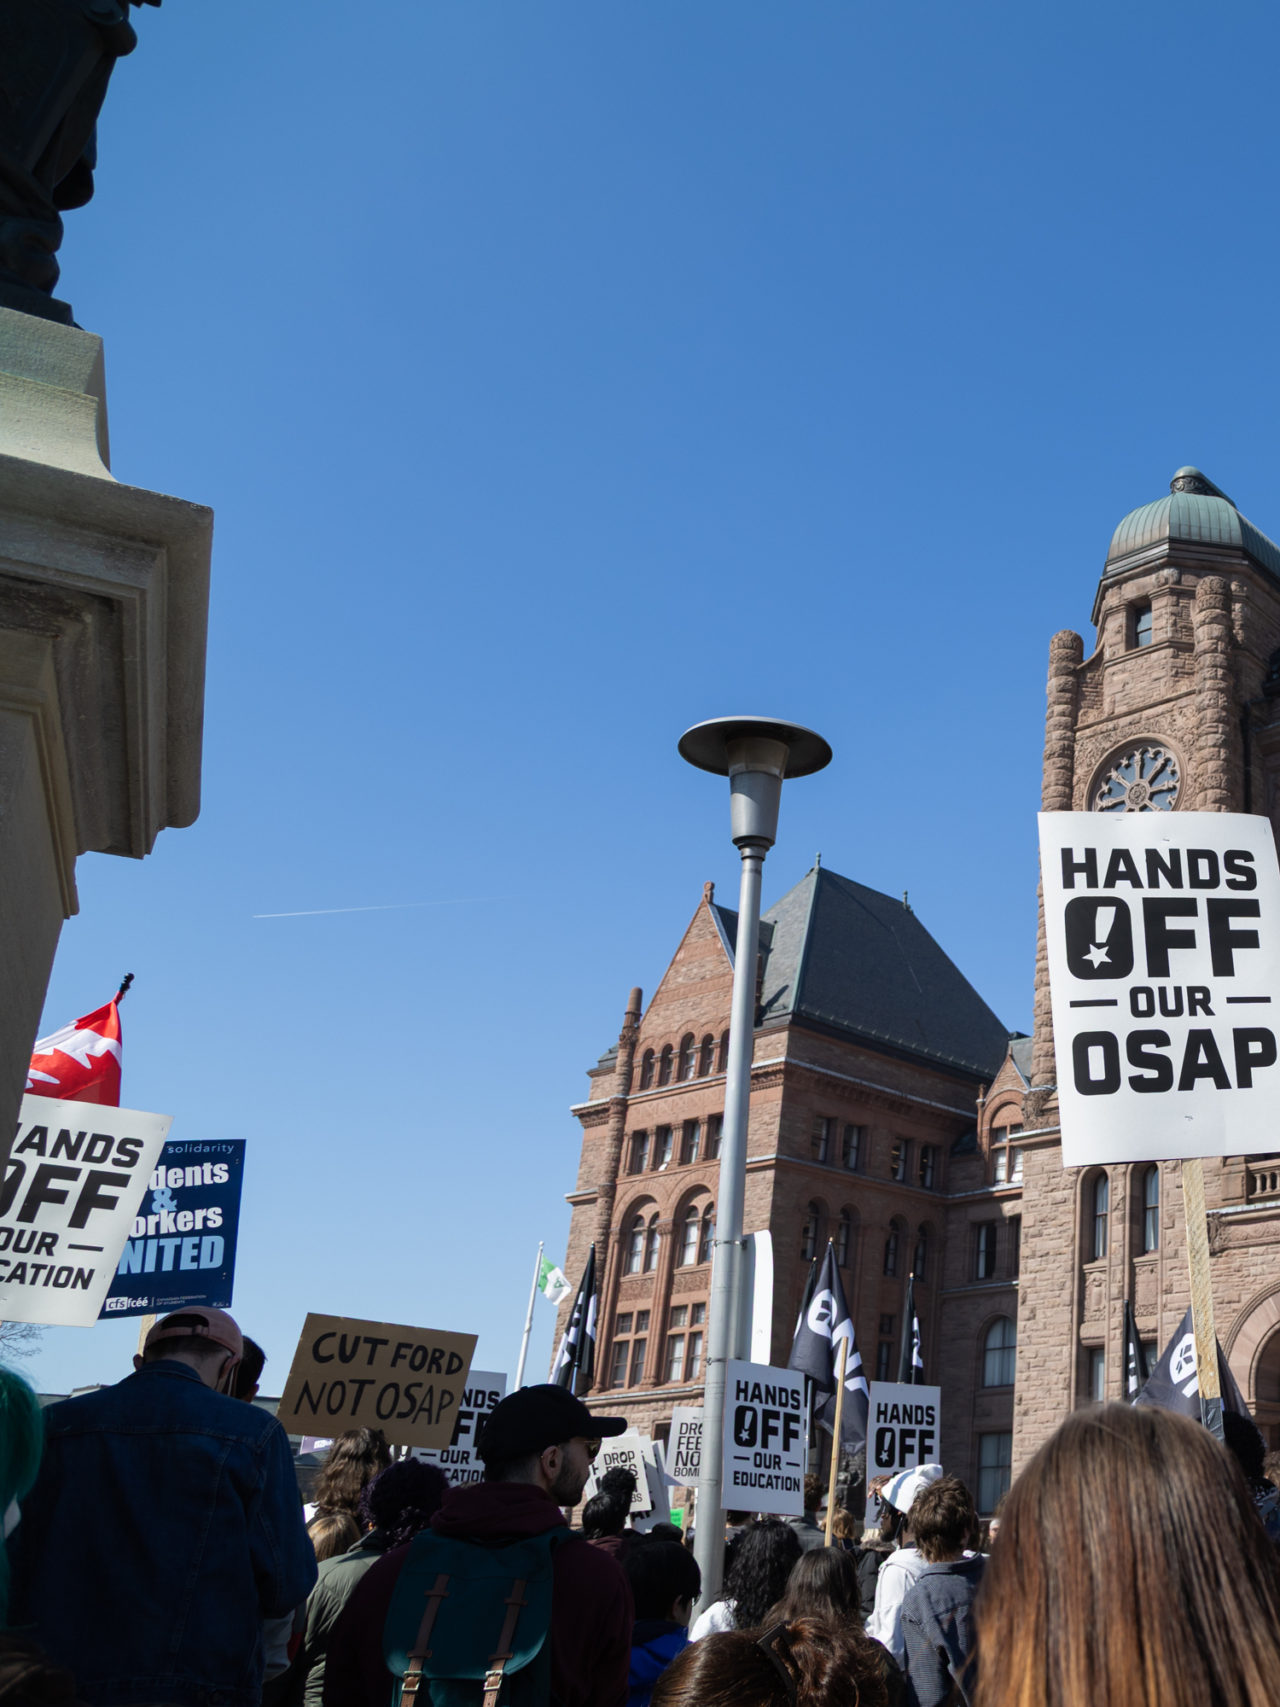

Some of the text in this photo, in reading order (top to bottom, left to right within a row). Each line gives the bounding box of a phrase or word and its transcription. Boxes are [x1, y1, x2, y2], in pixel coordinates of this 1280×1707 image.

[1061, 847, 1258, 891] HANDS
[1064, 896, 1261, 980] OFF
[1129, 986, 1216, 1018] OUR
[1072, 1027, 1278, 1096] OSAP
[13, 1122, 144, 1168] ANDS
[167, 1143, 235, 1155] solidarity
[148, 1162, 230, 1191] dents
[152, 1187, 178, 1213] &
[130, 1207, 224, 1238] orkers
[117, 1235, 225, 1275] NITED
[312, 1331, 464, 1376] CUT FORD
[293, 1378, 455, 1426] NOT OSAP
[459, 1388, 501, 1410] NDS
[735, 1379, 801, 1410] HANDS
[734, 1405, 801, 1452] OFF
[876, 1402, 936, 1426] HANDS
[440, 1450, 471, 1465] OUR
[604, 1450, 635, 1466] DROP
[677, 1436, 702, 1450] FEE
[875, 1427, 935, 1468] OFF
[674, 1467, 700, 1477] BOM
[675, 1451, 701, 1467] NO
[753, 1452, 782, 1470] OUR
[733, 1470, 801, 1492] EDUCATION
